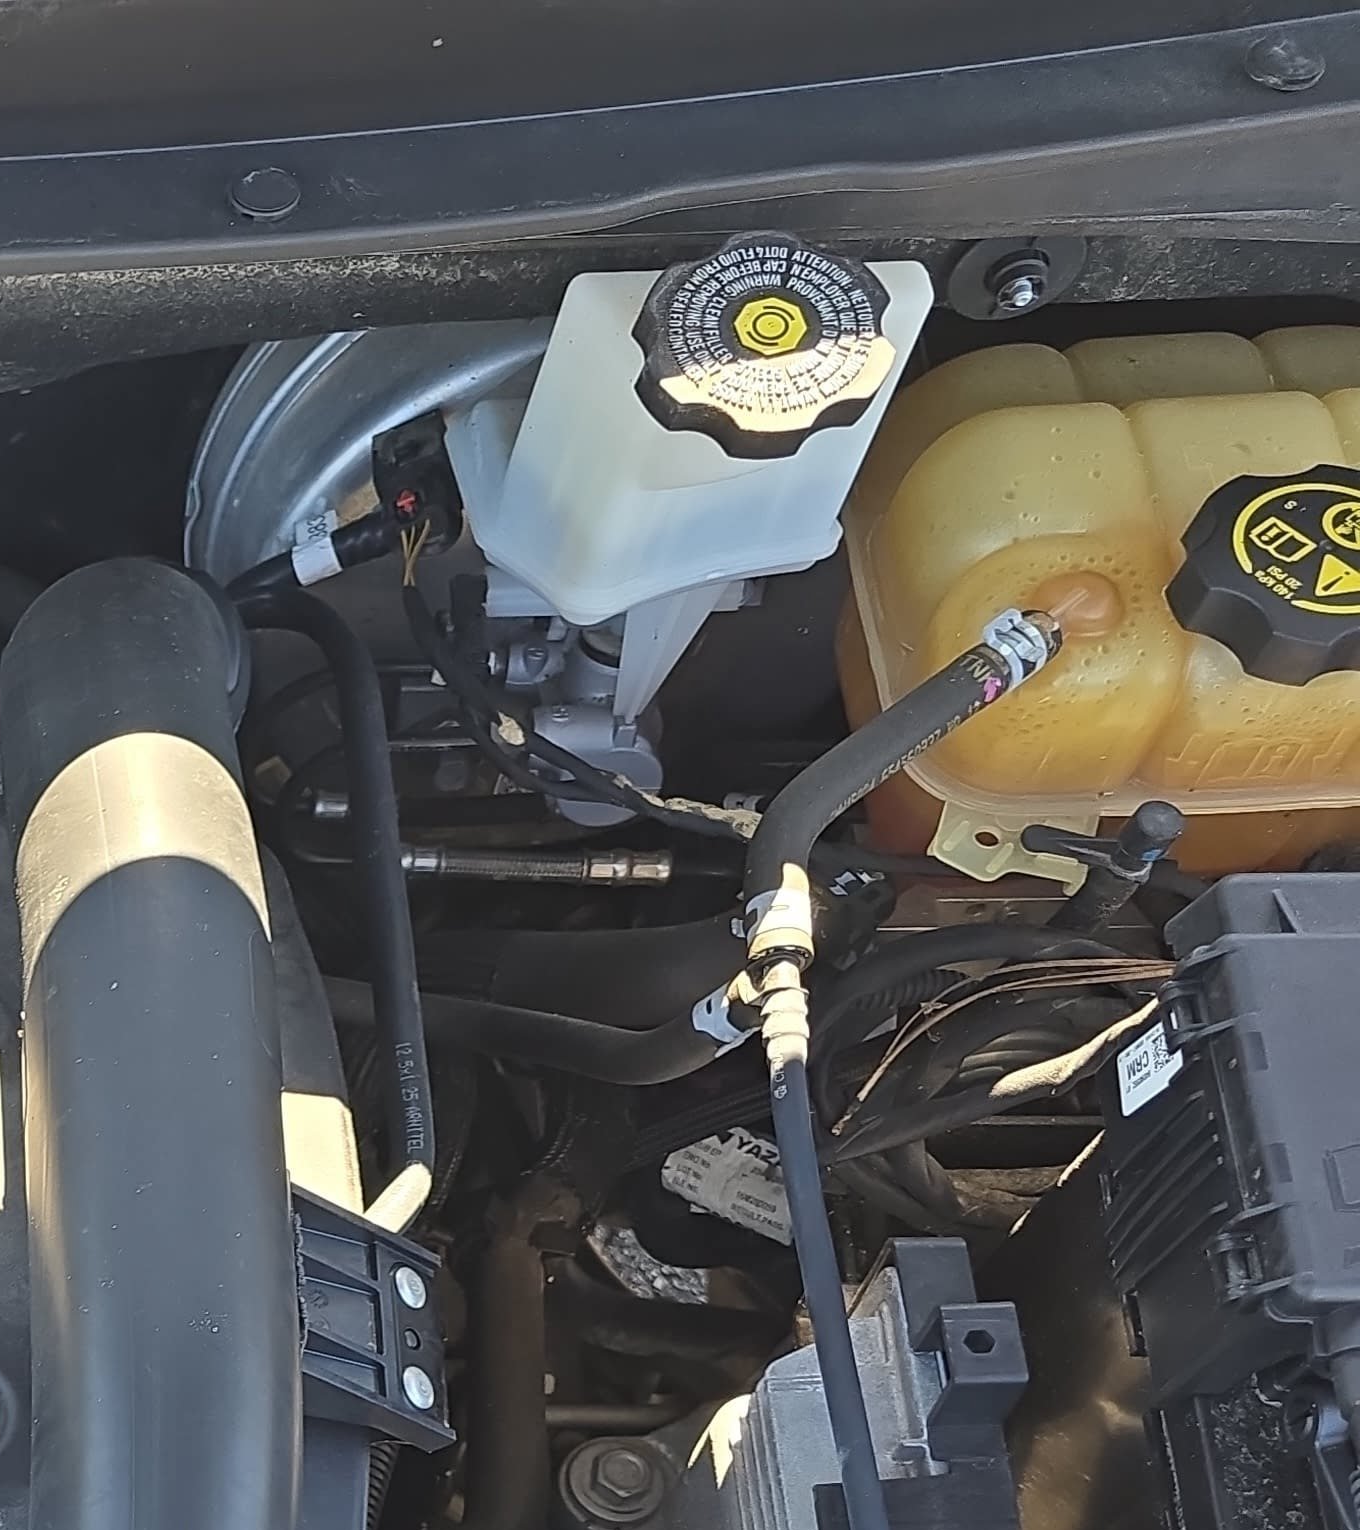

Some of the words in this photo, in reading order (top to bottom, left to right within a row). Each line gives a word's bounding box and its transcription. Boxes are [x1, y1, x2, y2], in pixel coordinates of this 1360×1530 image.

[719, 247, 756, 267] FLUID
[762, 259, 789, 271] CAP
[689, 260, 723, 286] FROM
[714, 260, 762, 286] BEFORE
[683, 282, 699, 292] A
[720, 273, 784, 300] WARNING:
[669, 290, 694, 326] SEALED
[704, 296, 730, 328] CLEAN
[788, 279, 838, 327] PROVENANT
[840, 312, 857, 331] QUE
[687, 333, 705, 352] USE
[704, 331, 734, 366] FILLER
